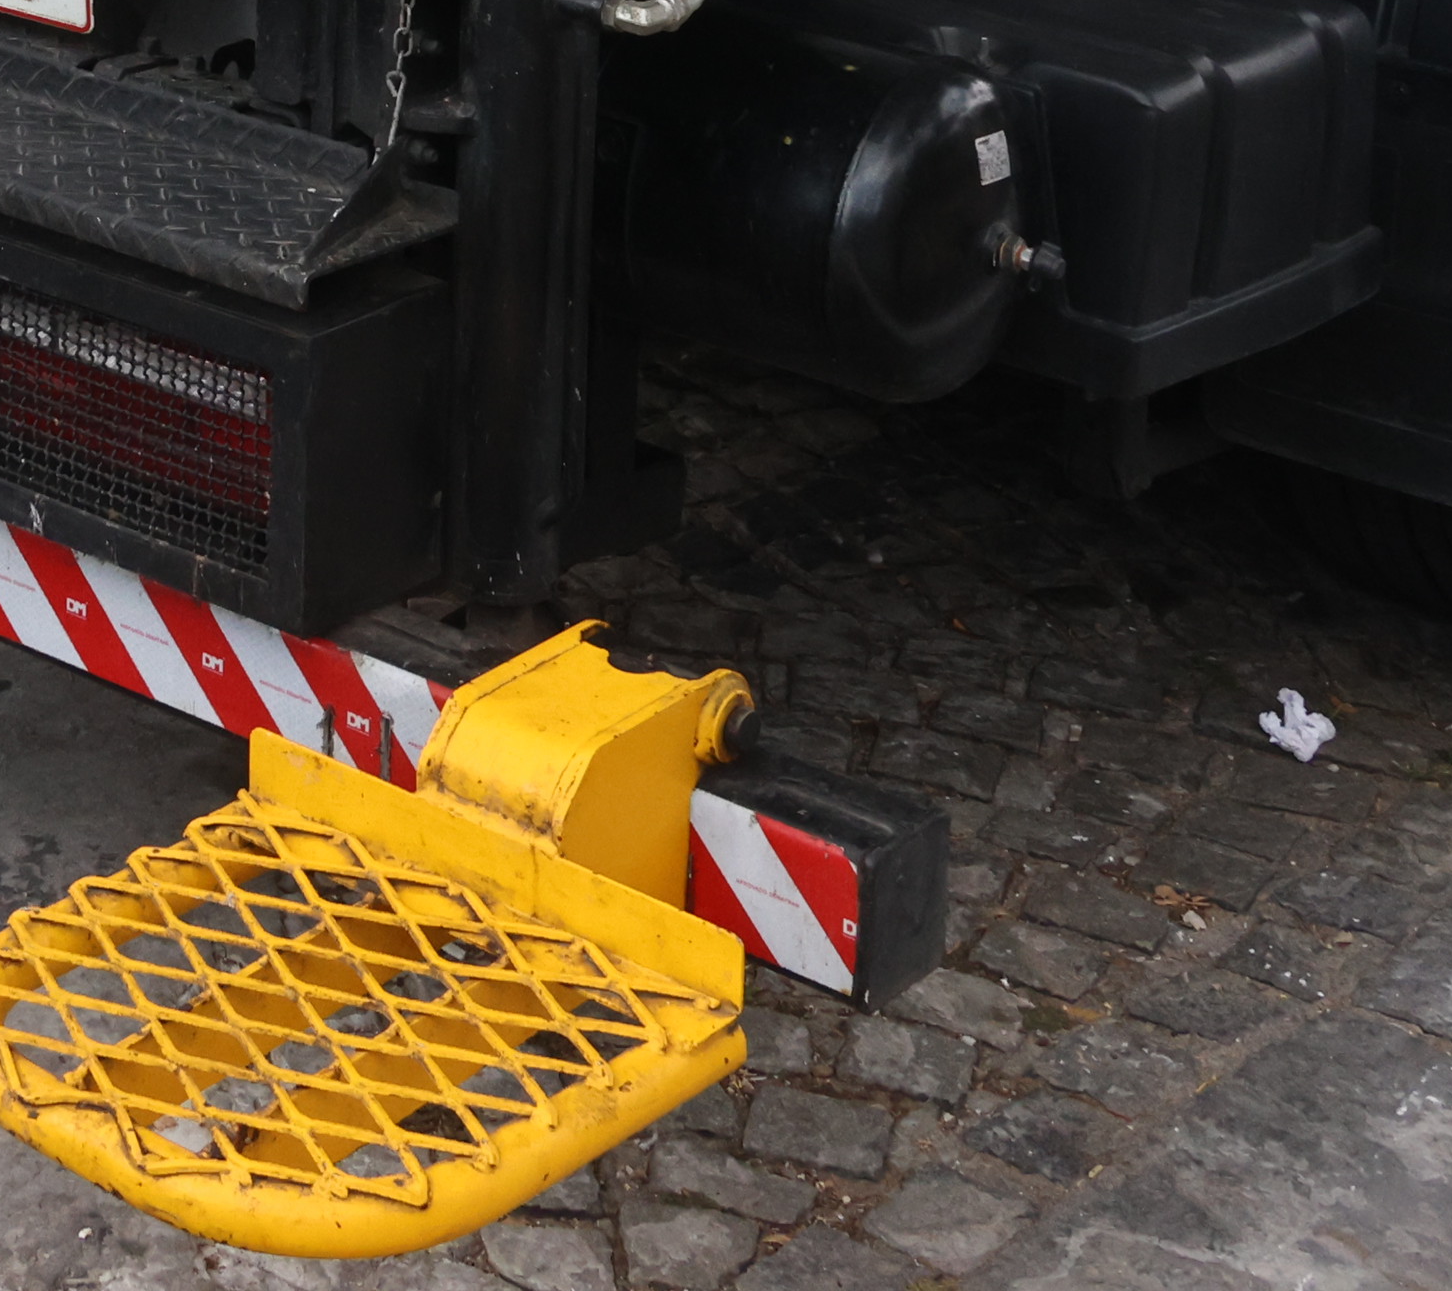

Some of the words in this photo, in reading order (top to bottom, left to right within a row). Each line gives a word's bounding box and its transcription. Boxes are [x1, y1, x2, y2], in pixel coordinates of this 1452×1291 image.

[66, 597, 87, 616] DM
[202, 652, 224, 672] DM
[346, 711, 370, 732] DM
